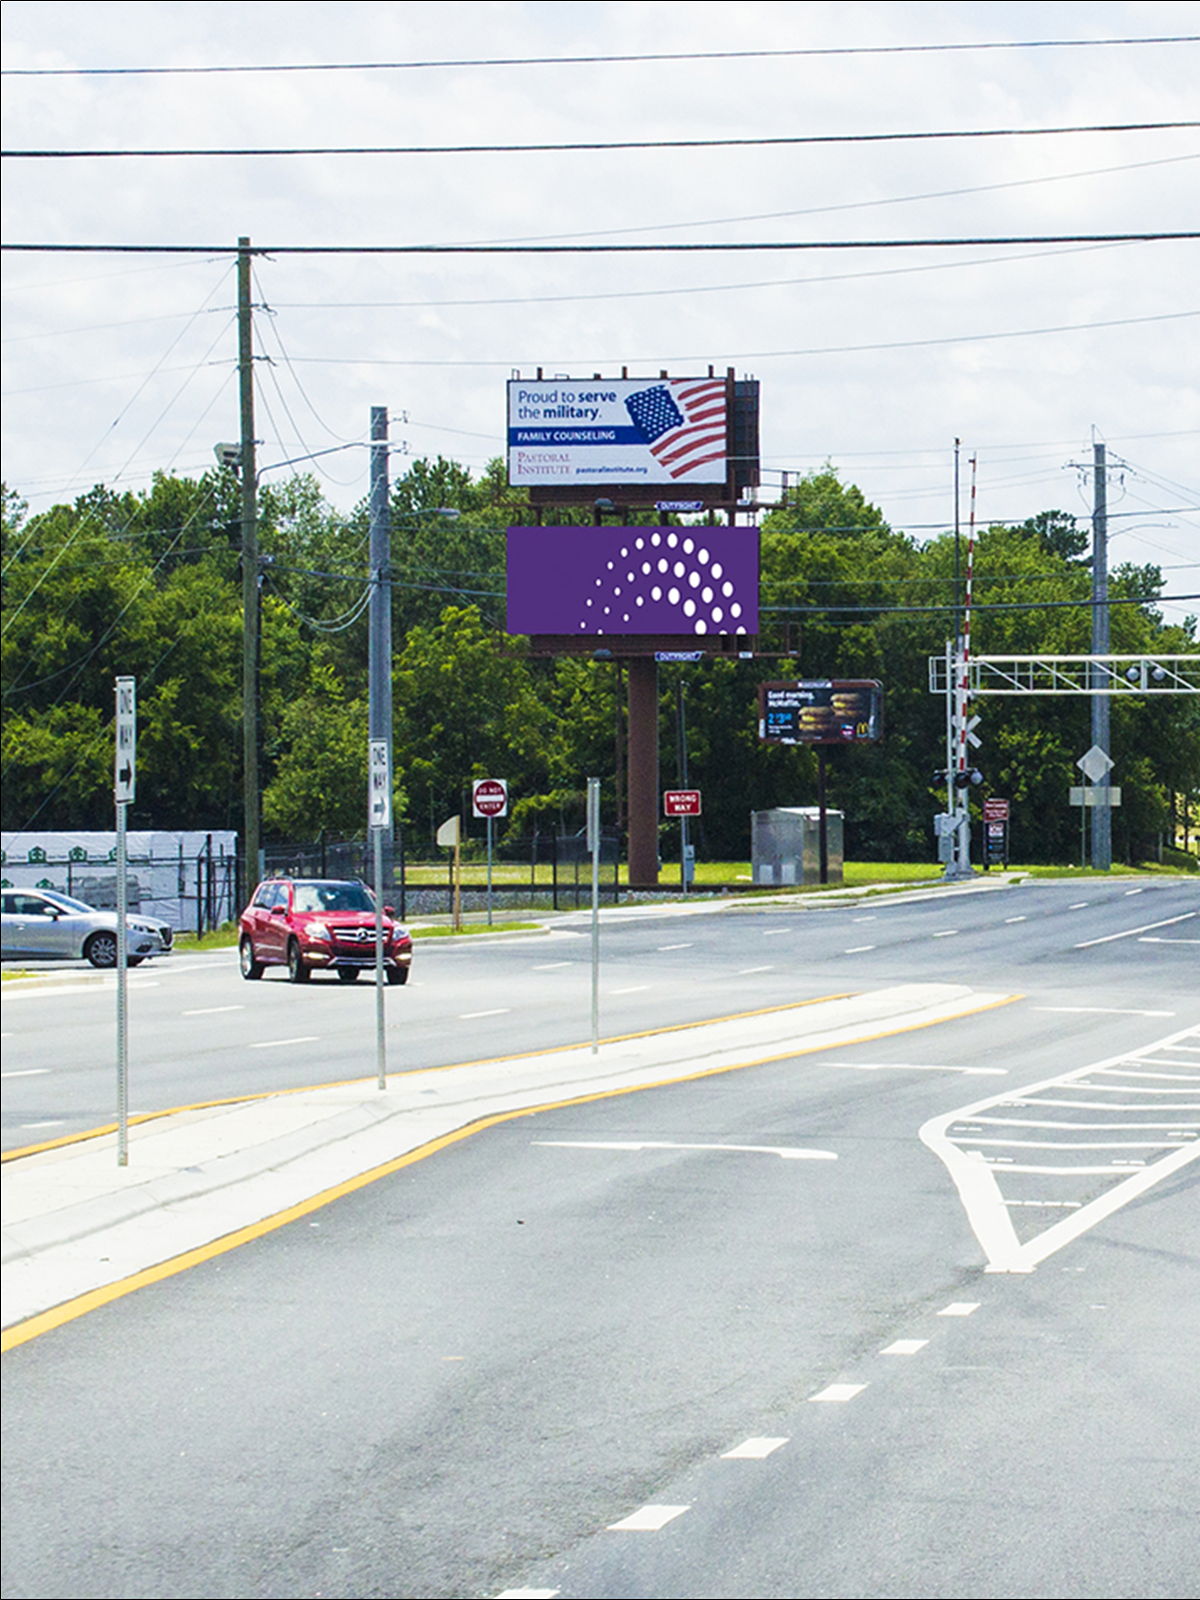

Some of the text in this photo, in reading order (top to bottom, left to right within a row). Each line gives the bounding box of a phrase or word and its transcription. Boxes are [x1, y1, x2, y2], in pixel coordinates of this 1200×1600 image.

[518, 389, 617, 404] Proud to serve
[518, 404, 603, 422] the military.
[517, 430, 616, 441] FAMILY COUNSELING
[575, 465, 648, 475] pastoralinstitute.org
[120, 688, 133, 714] ONE
[373, 746, 386, 766] ONE
[373, 772, 386, 790] WAY
[478, 786, 502, 794] DO NOT
[669, 794, 697, 803] WRONG
[479, 802, 501, 810] ENTER
[674, 803, 692, 812] WAY
